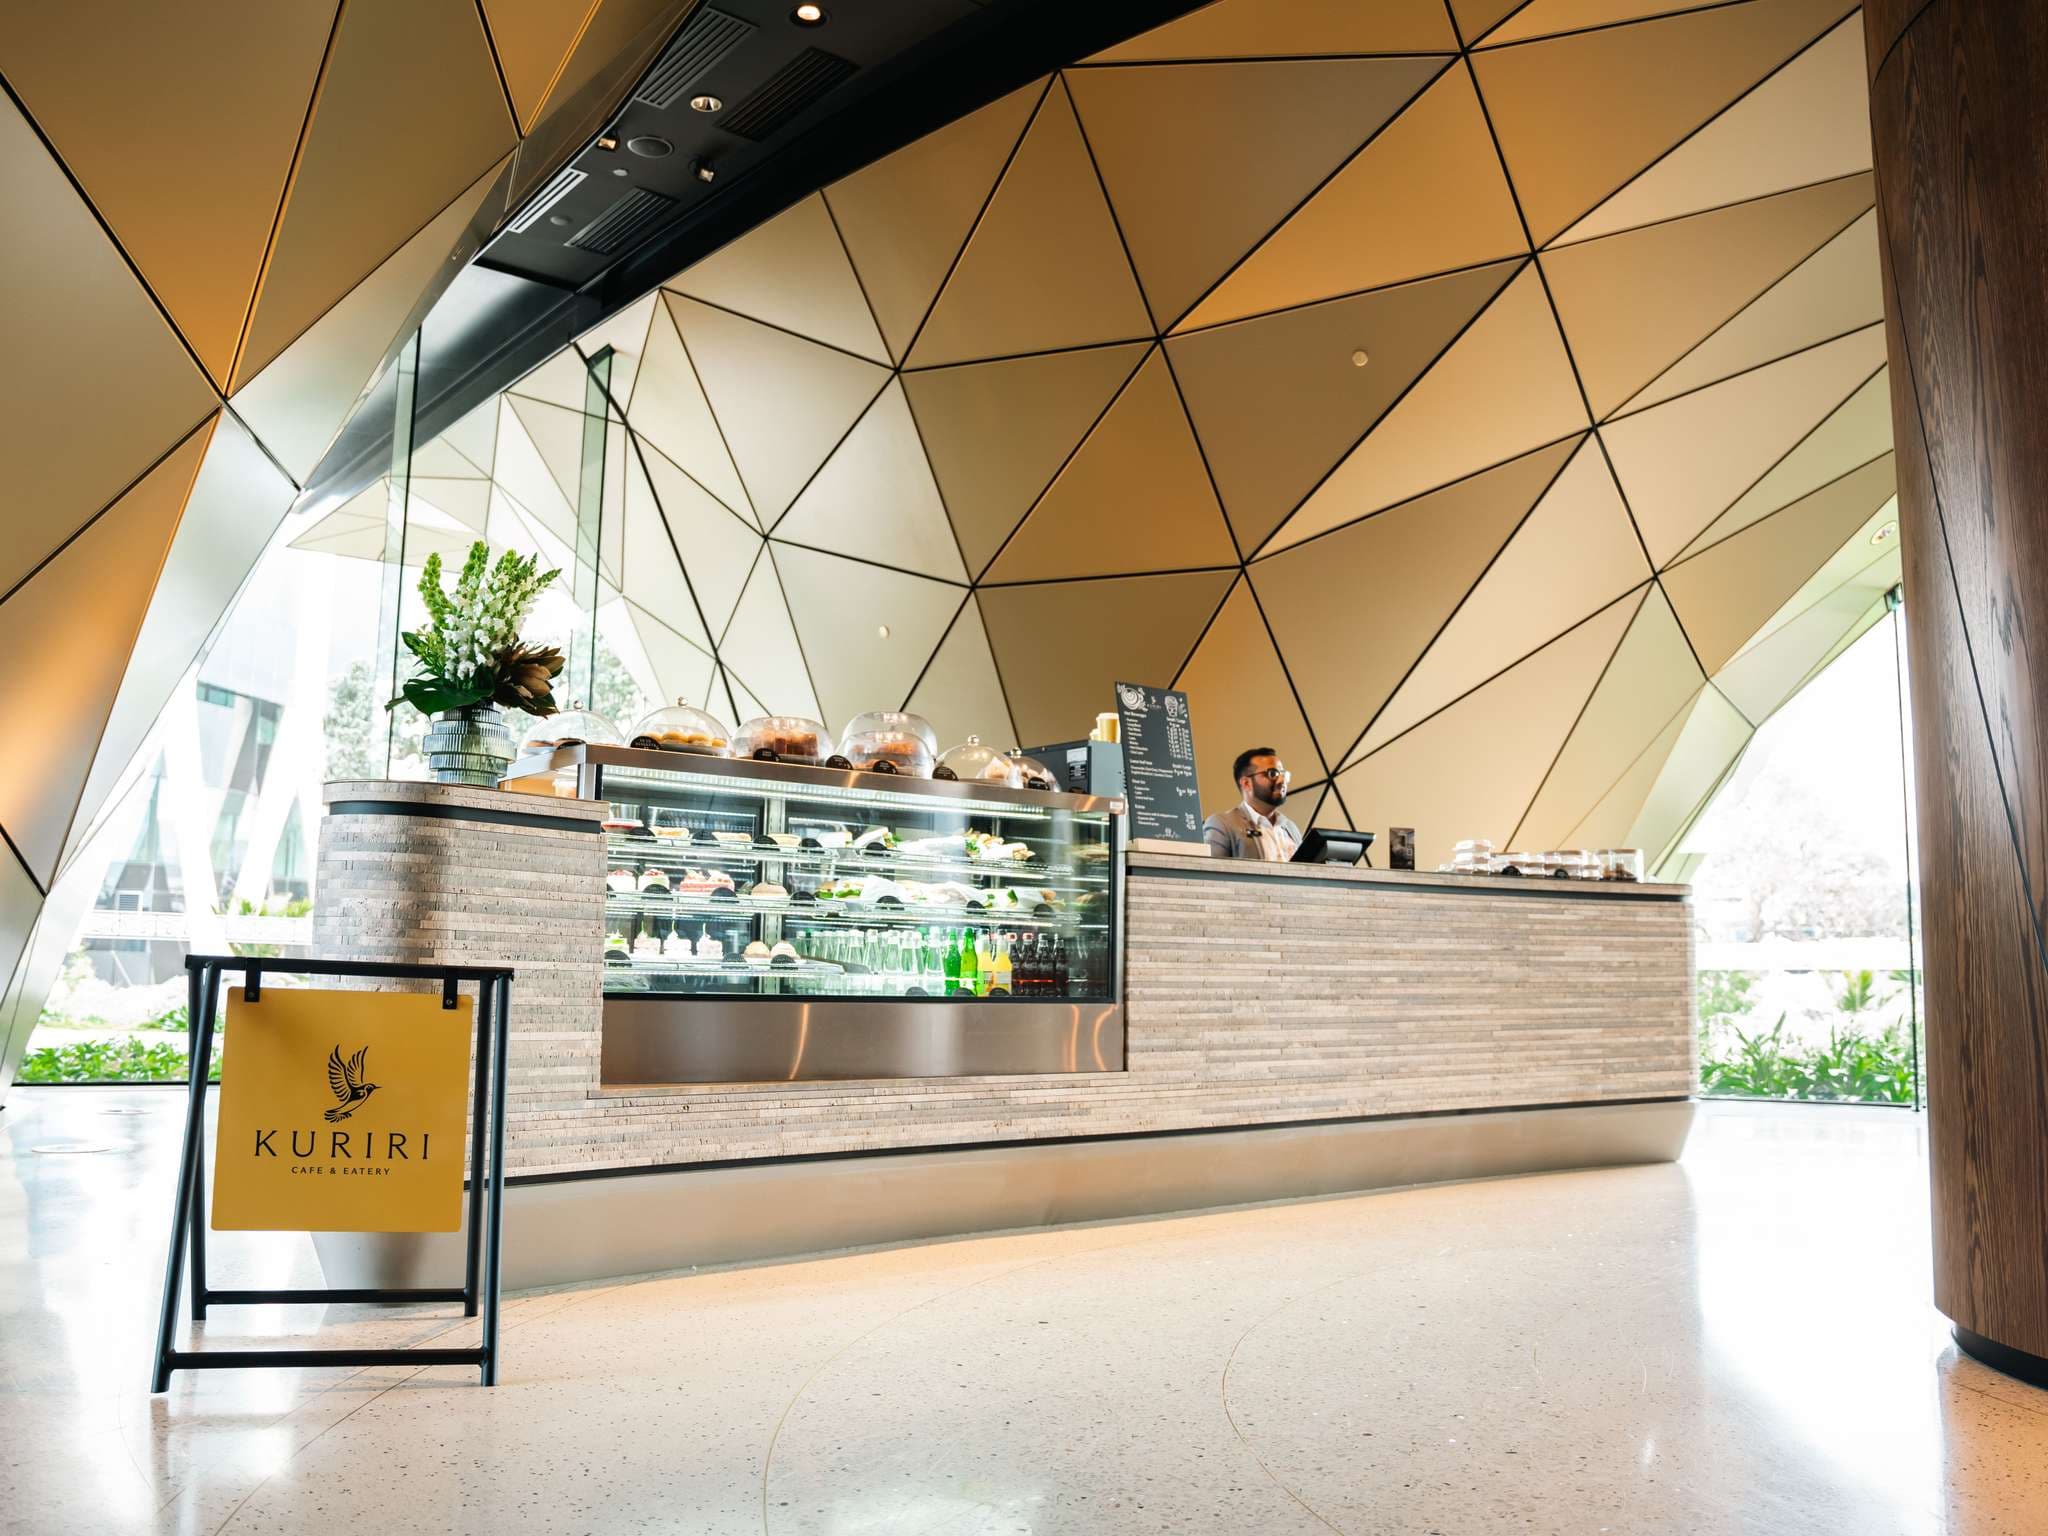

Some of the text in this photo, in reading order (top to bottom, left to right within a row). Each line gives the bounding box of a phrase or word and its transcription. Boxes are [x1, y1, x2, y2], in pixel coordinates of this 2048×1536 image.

[254, 1129, 430, 1160] KURIRI
[291, 1166, 391, 1176] CAFE & EATERY
